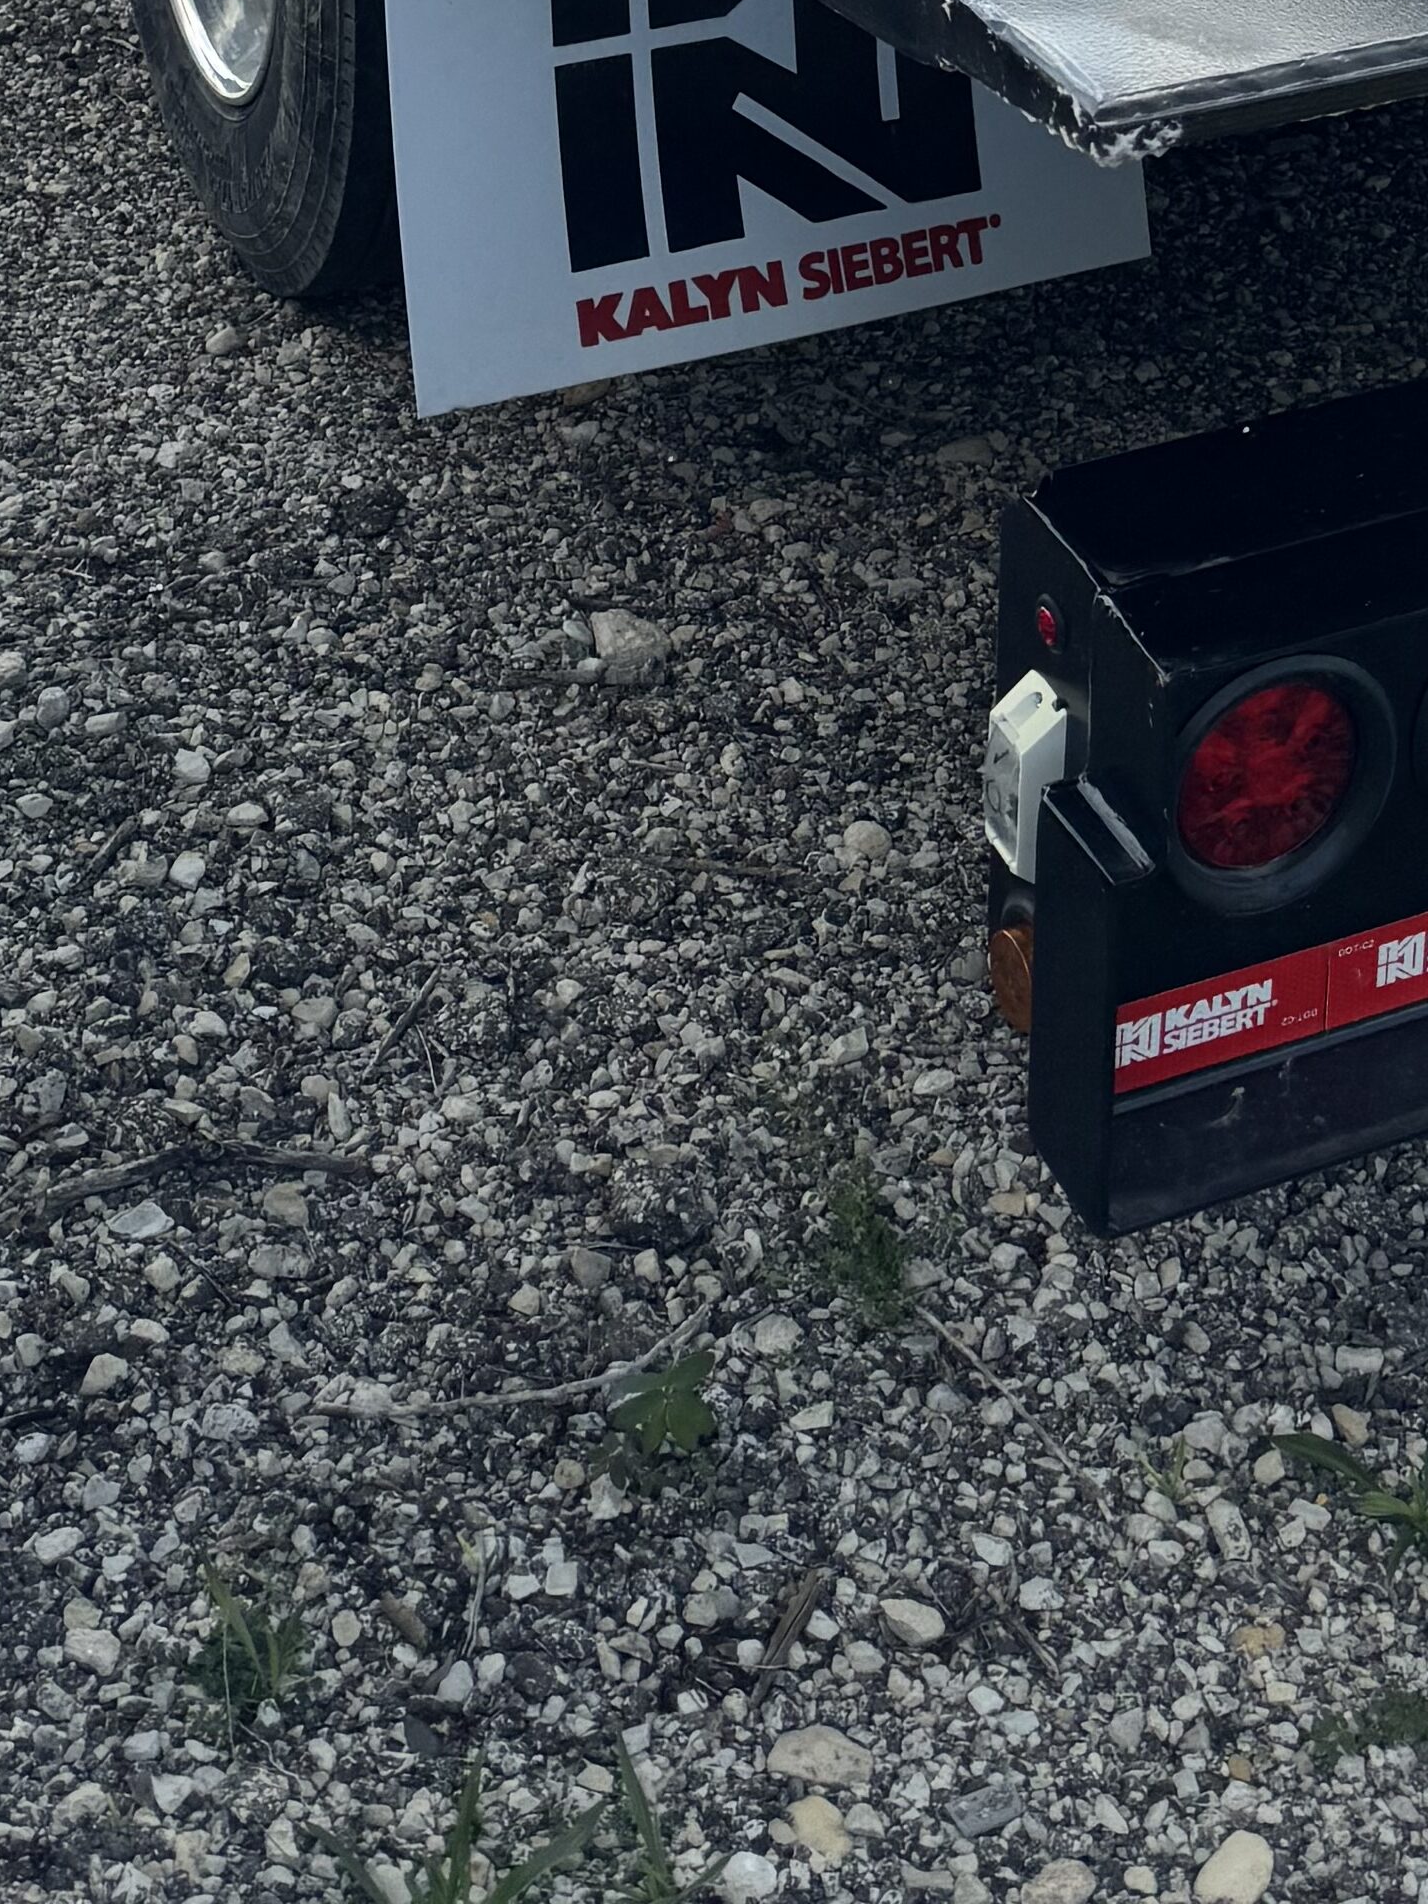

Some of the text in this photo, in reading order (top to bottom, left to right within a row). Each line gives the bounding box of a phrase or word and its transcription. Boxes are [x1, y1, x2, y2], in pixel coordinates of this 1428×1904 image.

[575, 215, 990, 348] KALYN SIEBERT
[1162, 1001, 1273, 1055] SIEBERT
[1163, 978, 1273, 1032] KALYN
